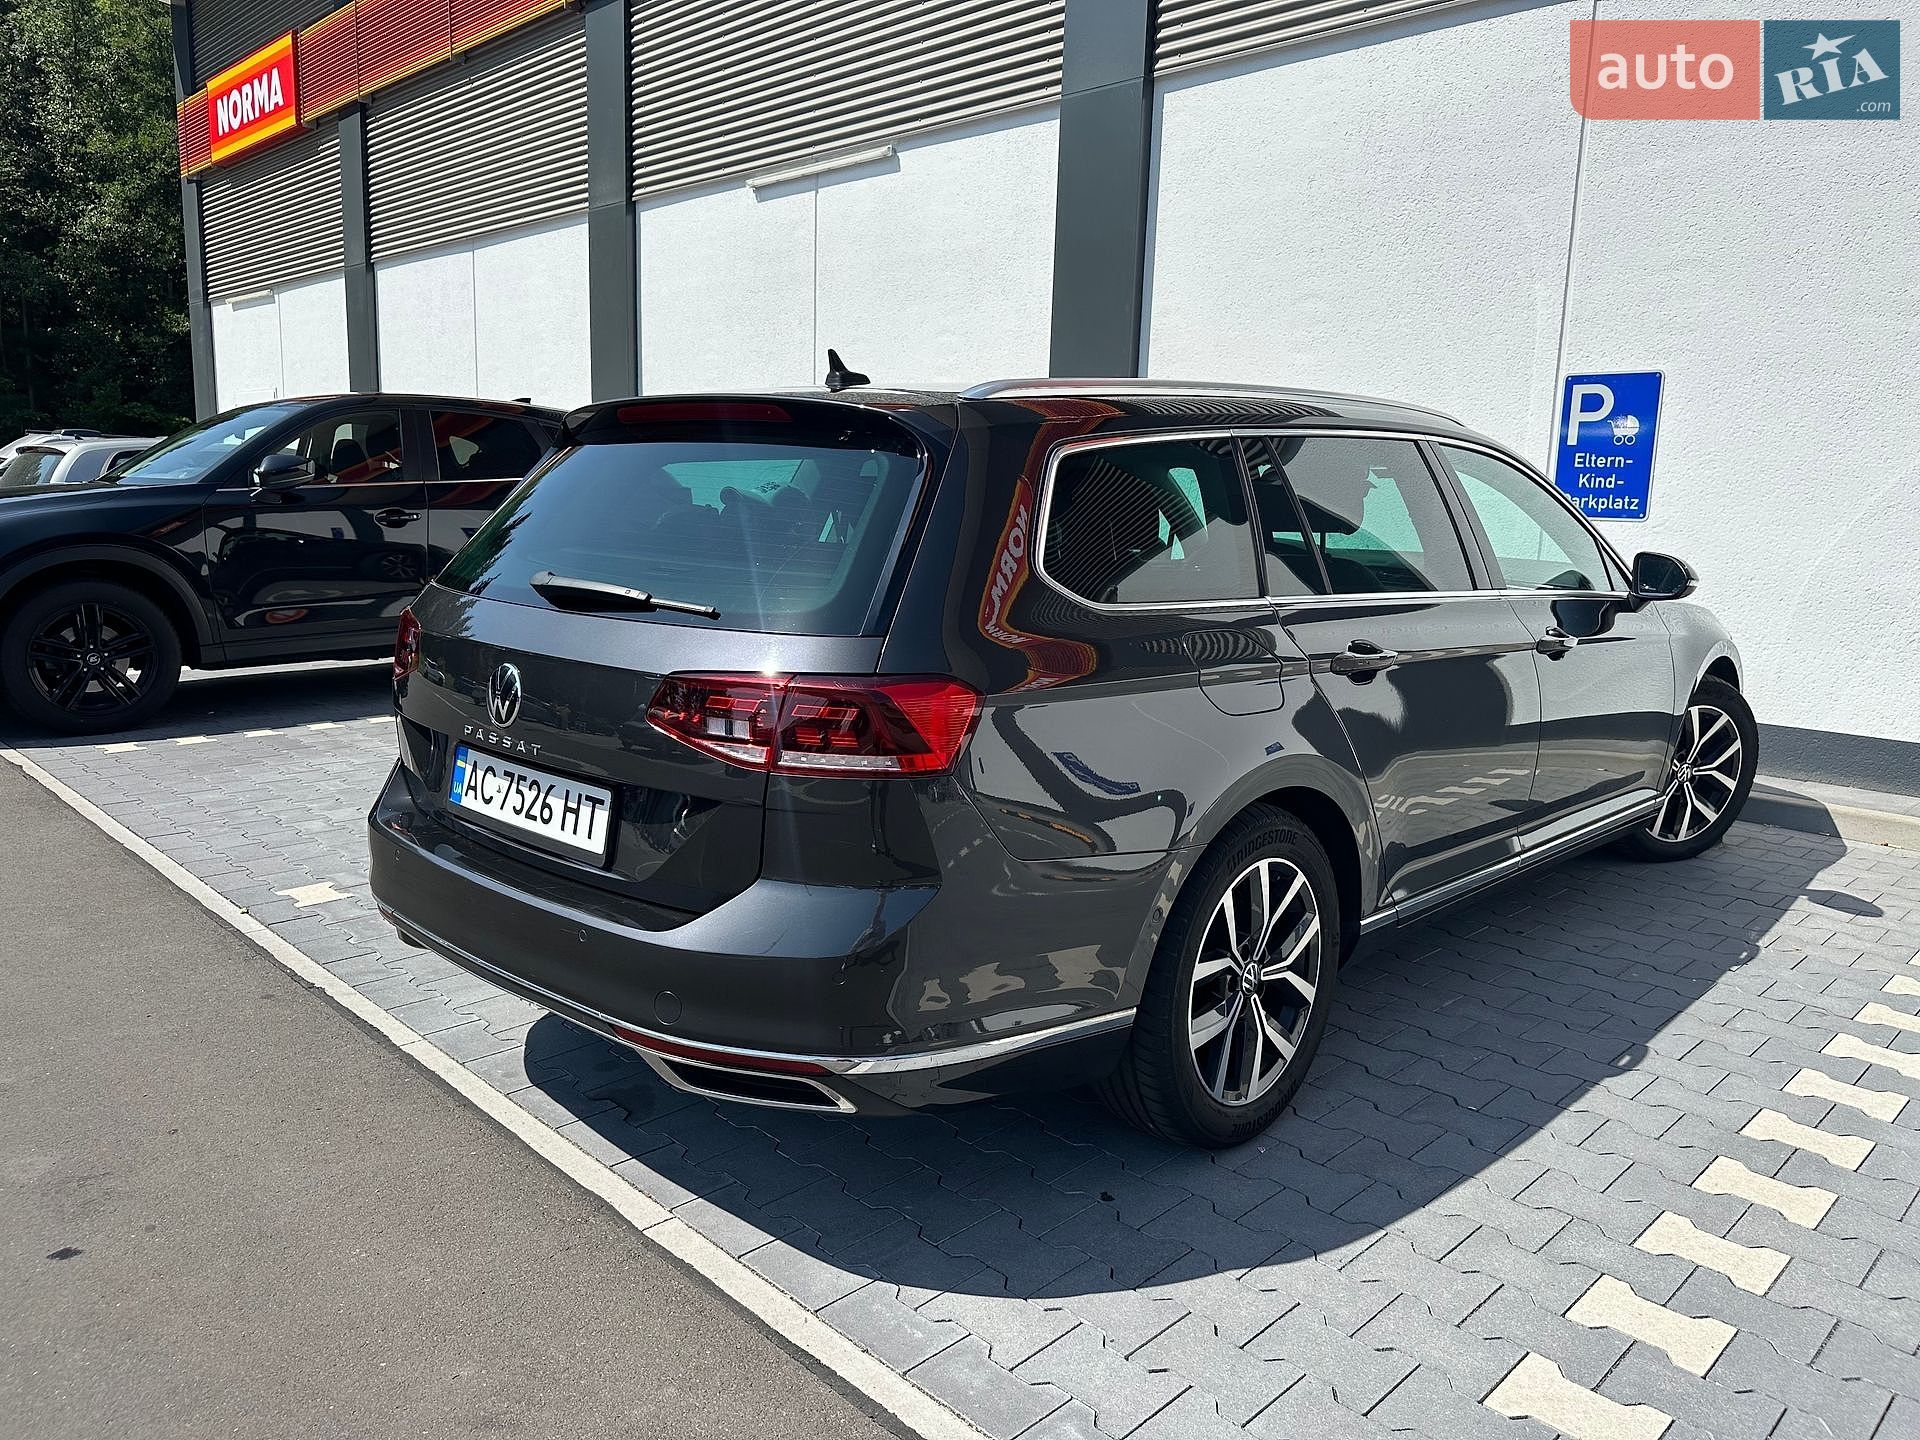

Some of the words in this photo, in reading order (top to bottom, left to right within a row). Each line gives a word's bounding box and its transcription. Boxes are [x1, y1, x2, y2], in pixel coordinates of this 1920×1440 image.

[217, 67, 284, 136] NORMA
[1567, 384, 1615, 446] P
[1574, 453, 1633, 468] Eltern-
[1579, 474, 1624, 488] Kind-
[464, 724, 542, 756] PASSAT
[453, 781, 463, 796] UA
[465, 761, 497, 804] AC
[500, 769, 556, 825] 7526
[560, 789, 605, 840] HT
